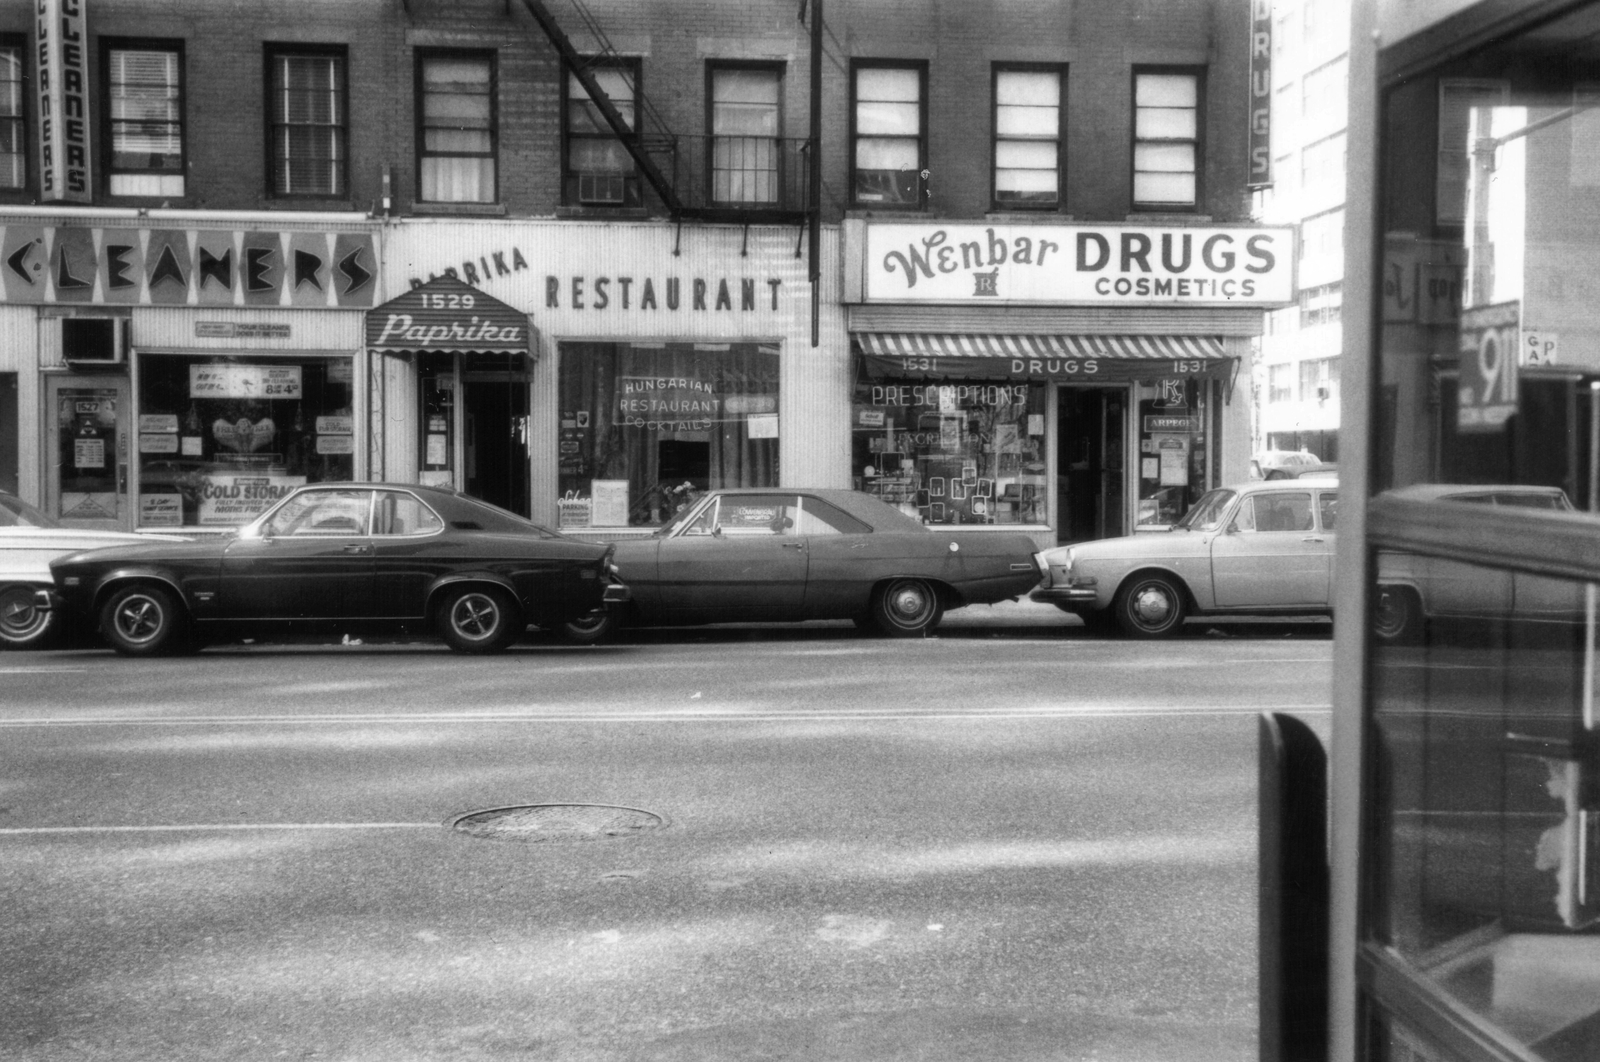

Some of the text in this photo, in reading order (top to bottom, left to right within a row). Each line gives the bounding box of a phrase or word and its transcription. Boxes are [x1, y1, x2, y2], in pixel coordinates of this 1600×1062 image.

[1252, 0, 1270, 174] DRUGS
[62, 0, 85, 193] CLEANERS
[883, 227, 1060, 289] Wenbar
[1076, 232, 1276, 274] DRUGS
[7, 239, 373, 295] CLEANERS
[545, 275, 782, 311] RESTAURANT
[1094, 277, 1256, 297] COSMETICS
[421, 294, 475, 310] 1529
[373, 314, 522, 346] Paprika
[902, 358, 937, 371] 1531
[1011, 359, 1099, 374] DRUGS
[1174, 360, 1207, 373] 1531
[625, 379, 712, 394] HUNGARIAN
[872, 385, 1026, 406] PRESCRIPTIONS
[77, 402, 99, 412] 1527
[620, 400, 720, 412] RESTAURANT
[625, 415, 712, 432] COCKTAILS
[203, 482, 240, 499] COLD
